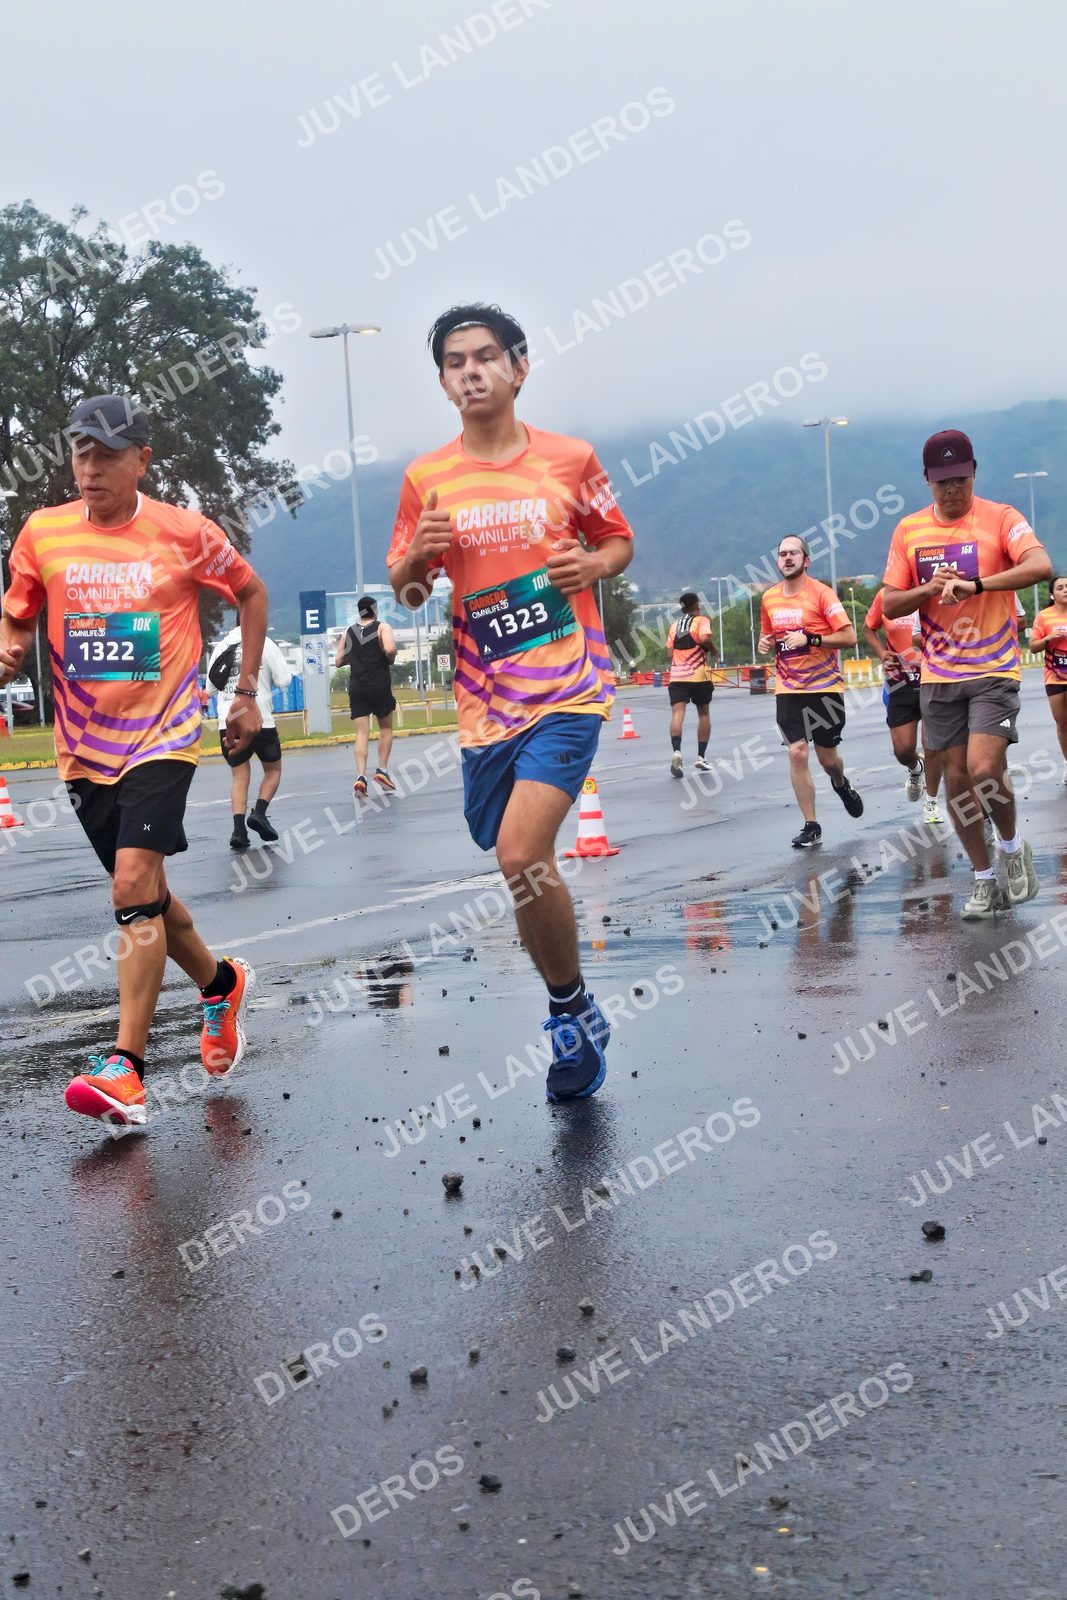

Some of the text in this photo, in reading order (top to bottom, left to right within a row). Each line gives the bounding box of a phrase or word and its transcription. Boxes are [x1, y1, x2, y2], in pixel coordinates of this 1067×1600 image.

[456, 498, 547, 532] CARRERA
[65, 562, 152, 584] CARRERA
[531, 572, 552, 591] 10K
[468, 589, 508, 612] CARRERA
[132, 617, 152, 631] 10K
[306, 609, 320, 629] E
[488, 602, 549, 638] 1323
[79, 641, 135, 661] 1322
